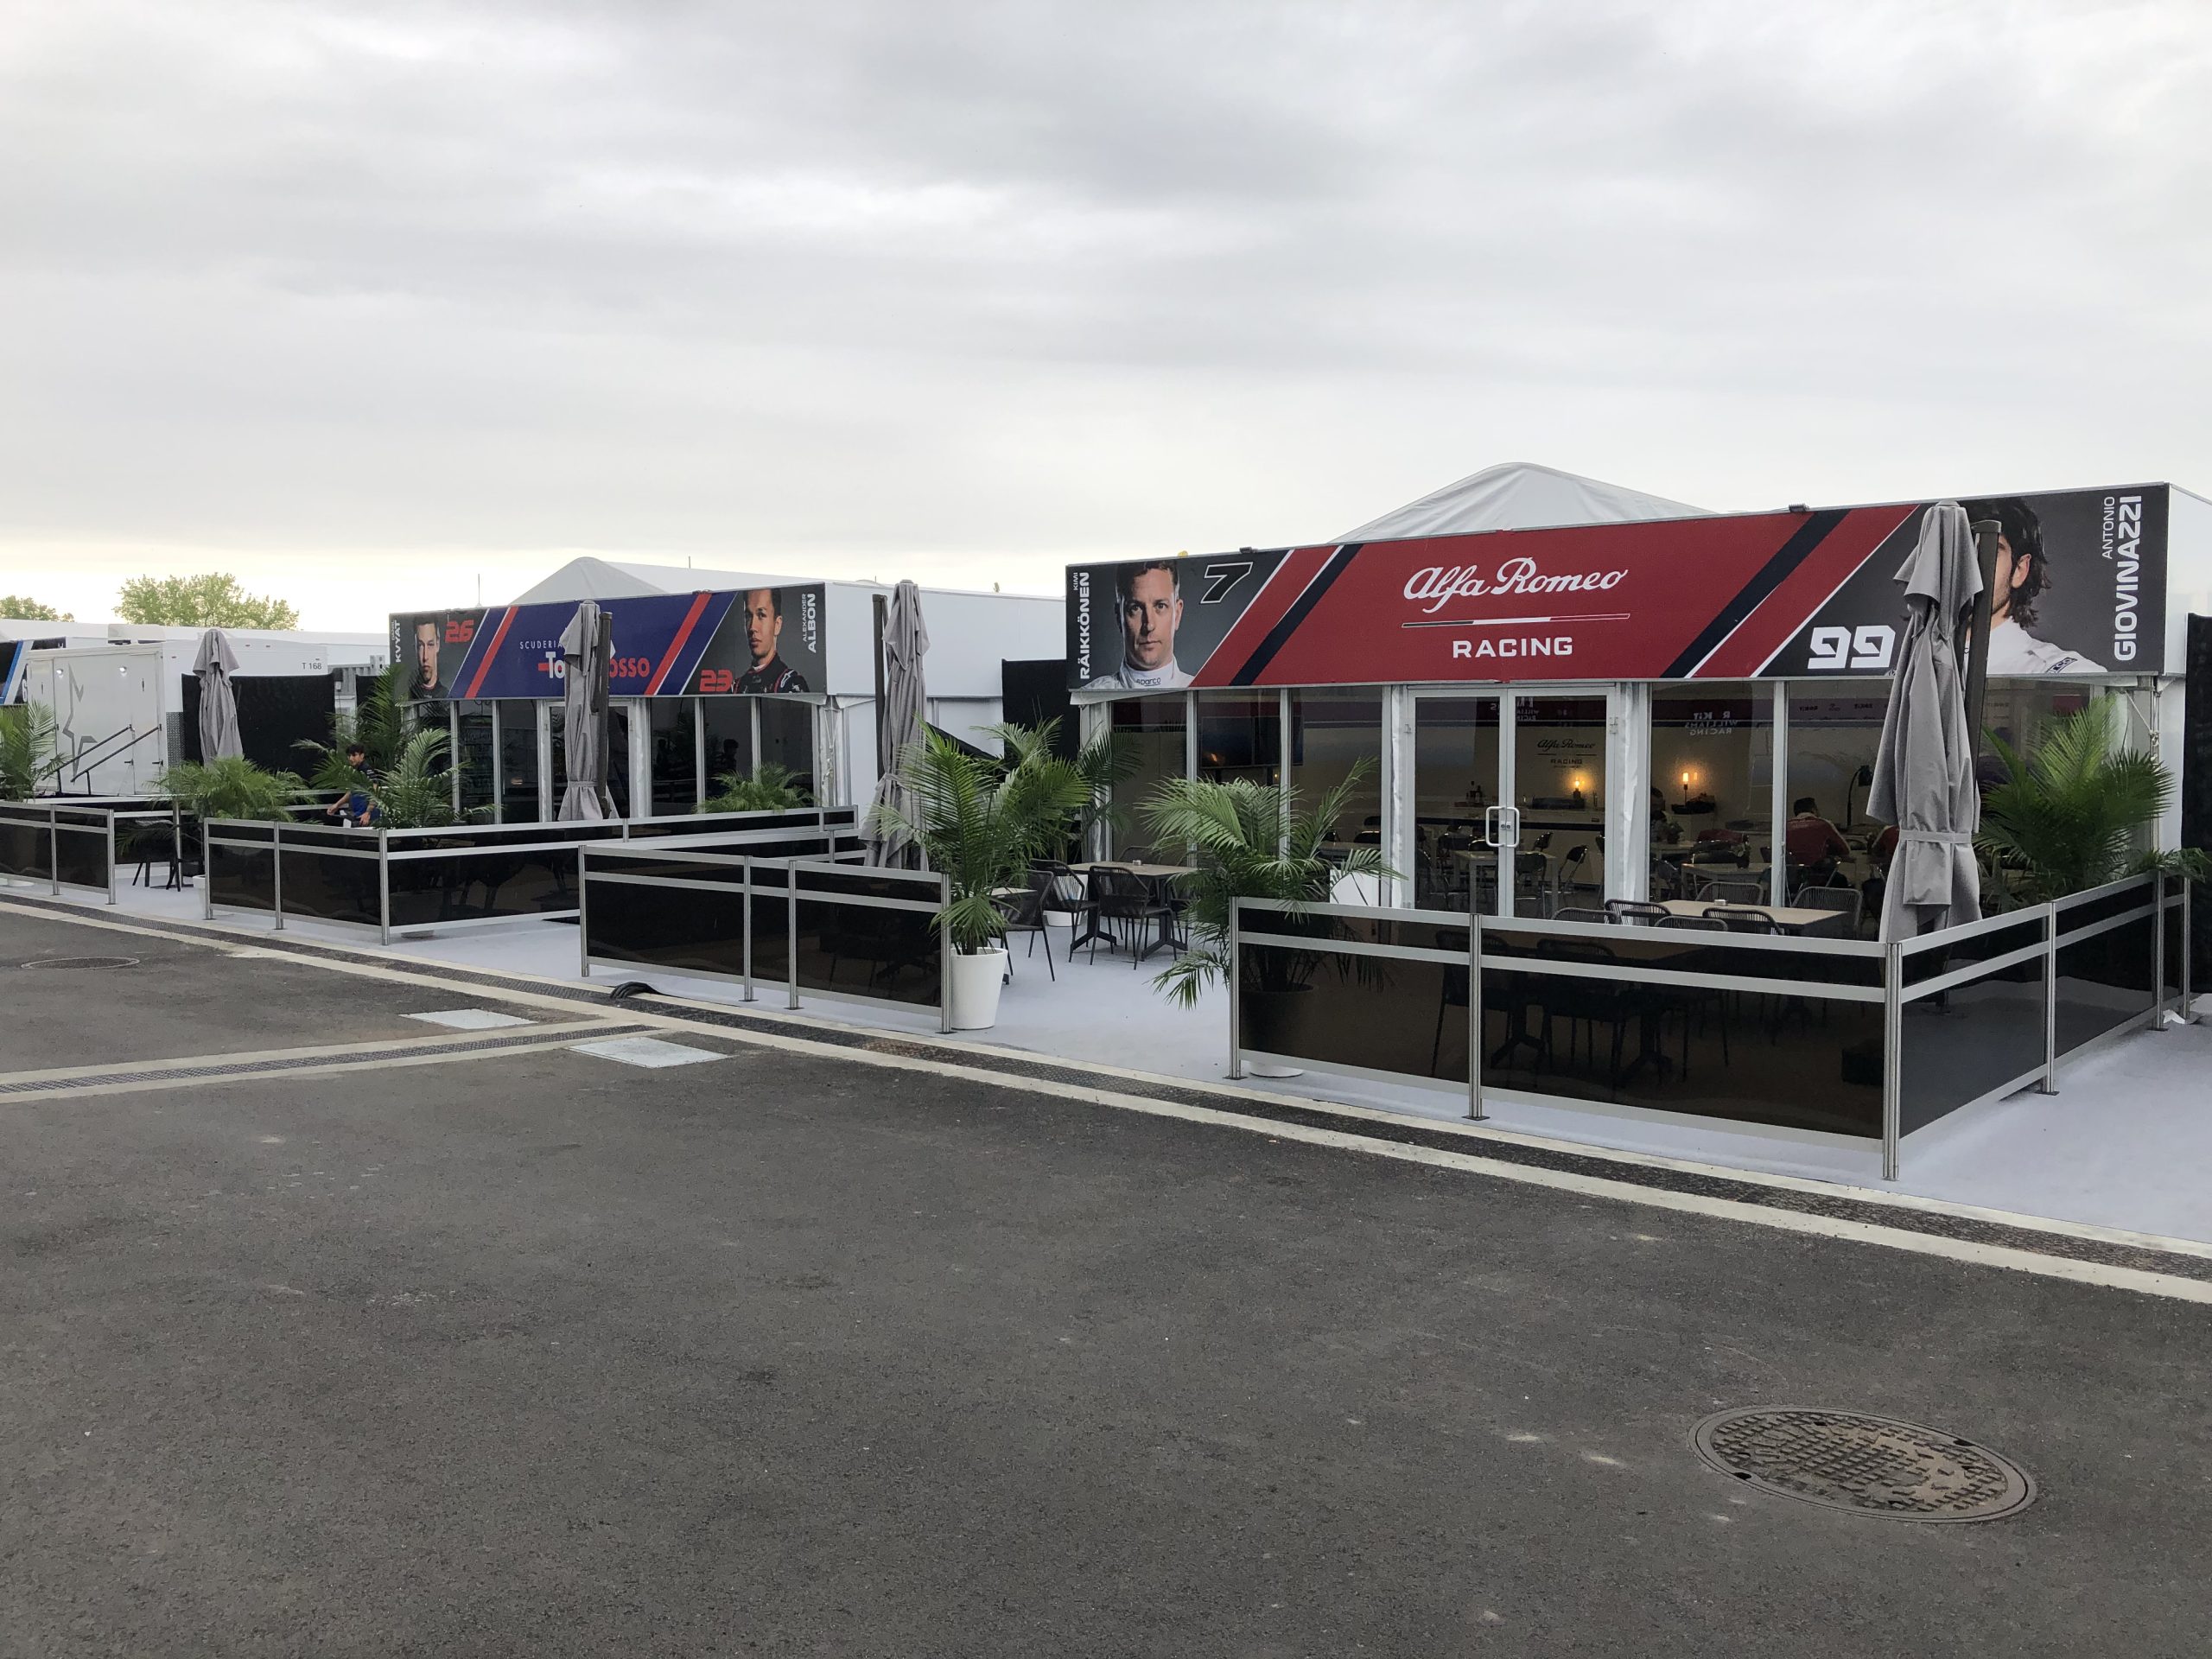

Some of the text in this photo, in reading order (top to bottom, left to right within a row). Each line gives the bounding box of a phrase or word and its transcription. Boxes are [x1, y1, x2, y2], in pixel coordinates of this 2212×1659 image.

[2101, 496, 2115, 560] ANTONIO
[1200, 562, 1254, 605] 7
[1403, 556, 1629, 613] Alfa Romeo
[2113, 495, 2142, 661] GIOVINAZZI
[445, 619, 474, 643] 26
[807, 593, 817, 653] ALBON
[1077, 572, 1090, 679] RÄIKKÖNEN
[1452, 637, 1573, 658] RACING
[1807, 625, 1897, 670] 99
[699, 669, 733, 692] 23
